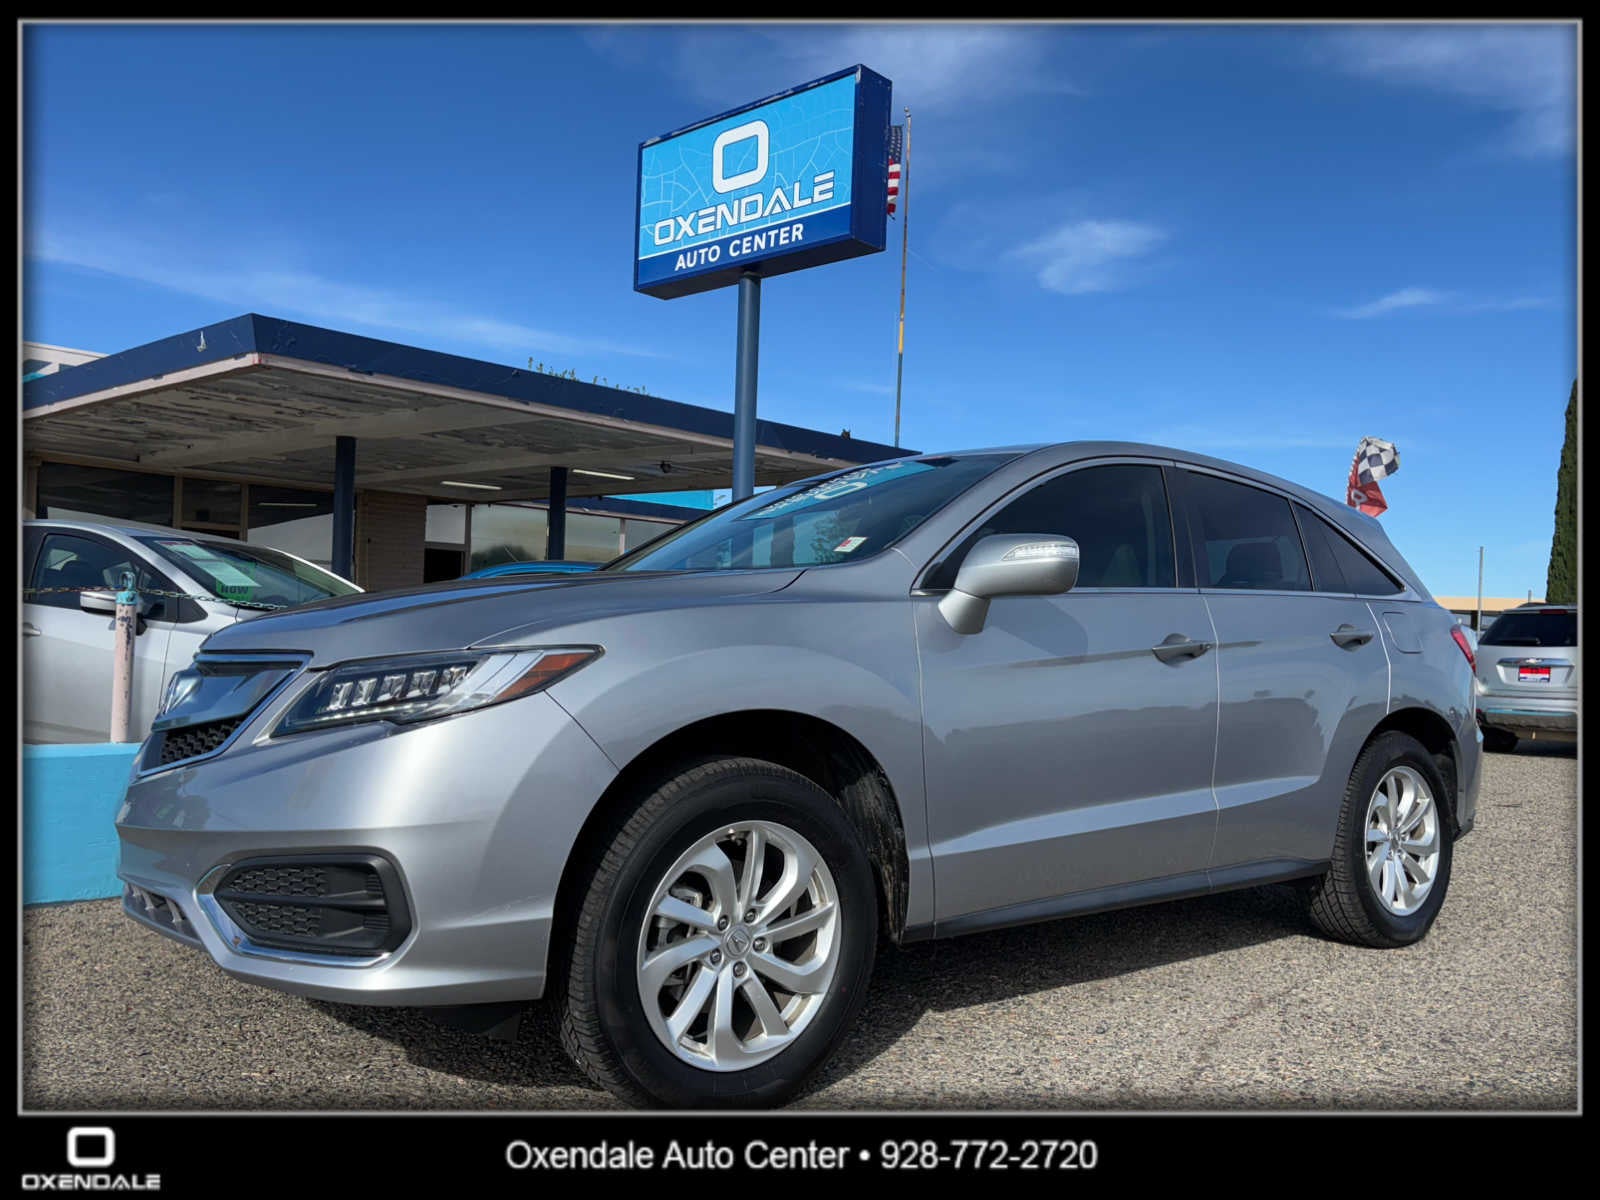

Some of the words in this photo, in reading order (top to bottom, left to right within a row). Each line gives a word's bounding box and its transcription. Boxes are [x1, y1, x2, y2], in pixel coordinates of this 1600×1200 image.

[654, 170, 835, 246] OXENDALE
[675, 245, 720, 271] AUTO
[729, 223, 804, 257] CENTER
